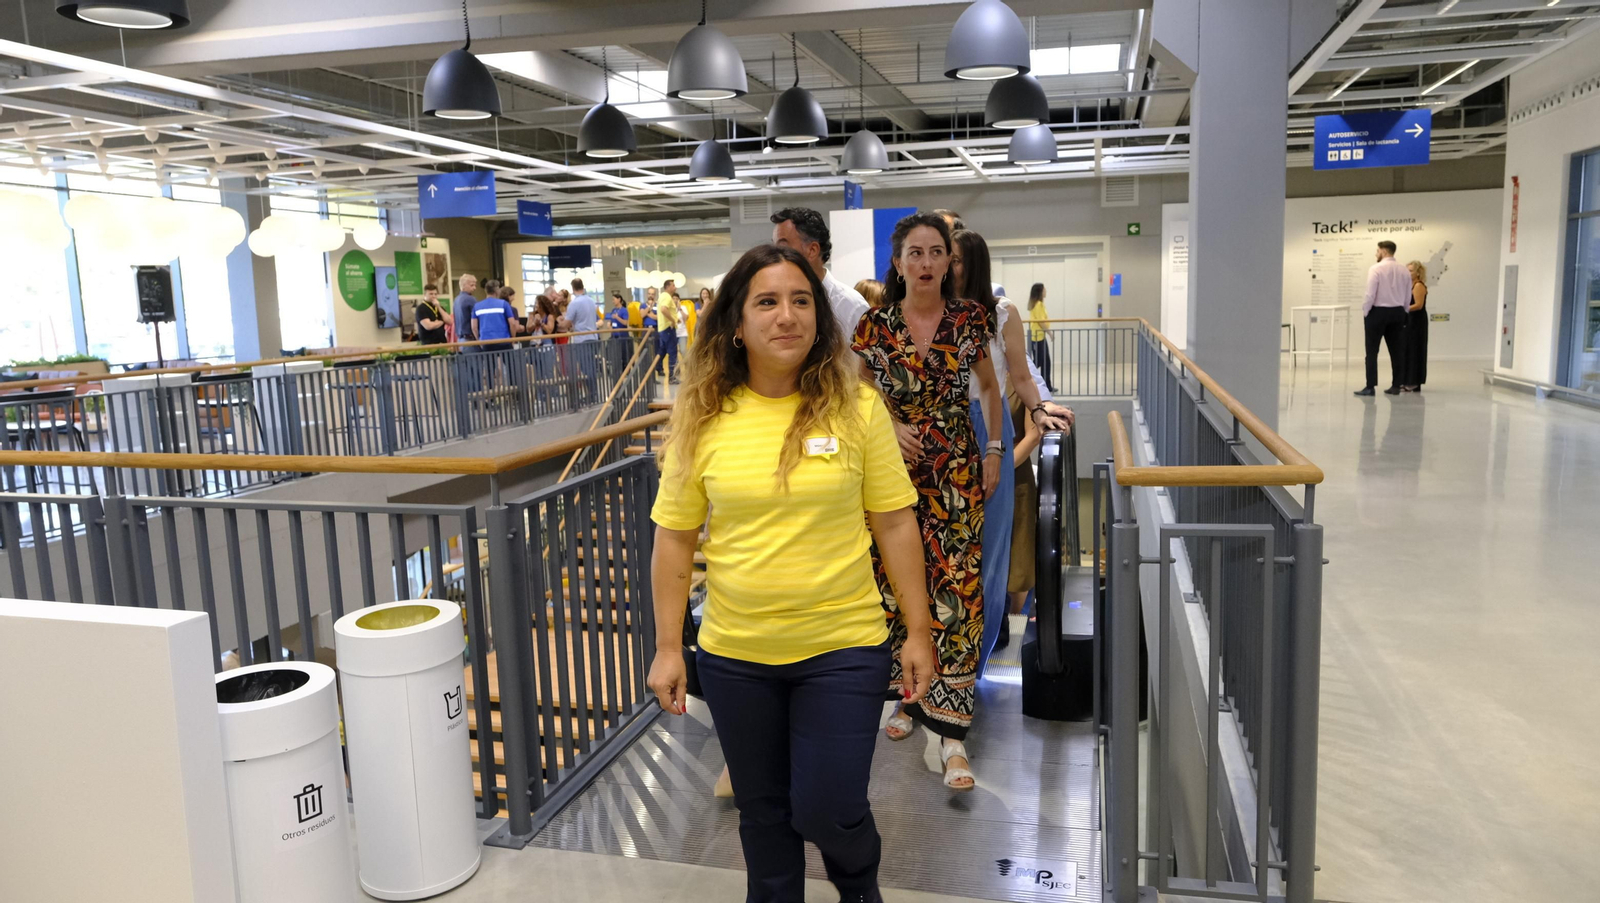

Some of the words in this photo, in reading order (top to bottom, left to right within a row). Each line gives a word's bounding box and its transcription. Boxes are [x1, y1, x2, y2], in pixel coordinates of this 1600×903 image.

[1328, 131, 1369, 139] AUTOSERVICIO
[1390, 226, 1403, 234] por
[281, 827, 306, 841] Otros
[307, 813, 336, 833] residuos
[1041, 880, 1071, 890] SJEC
